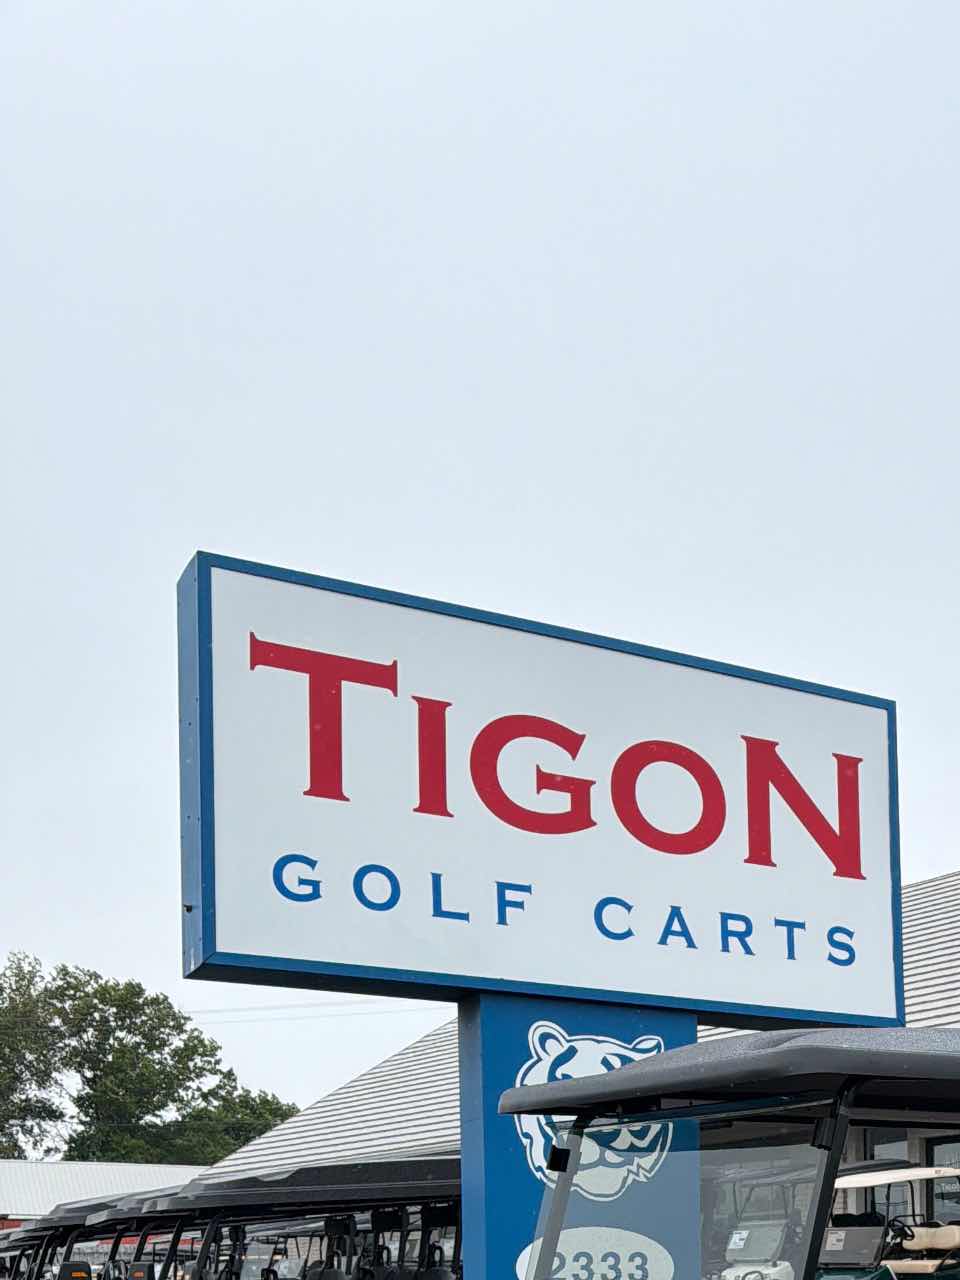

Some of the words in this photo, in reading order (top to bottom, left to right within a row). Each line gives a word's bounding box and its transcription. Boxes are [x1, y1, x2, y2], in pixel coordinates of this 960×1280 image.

[250, 631, 867, 880] TIGON
[272, 854, 532, 926] GOLF
[593, 895, 857, 967] CARTS
